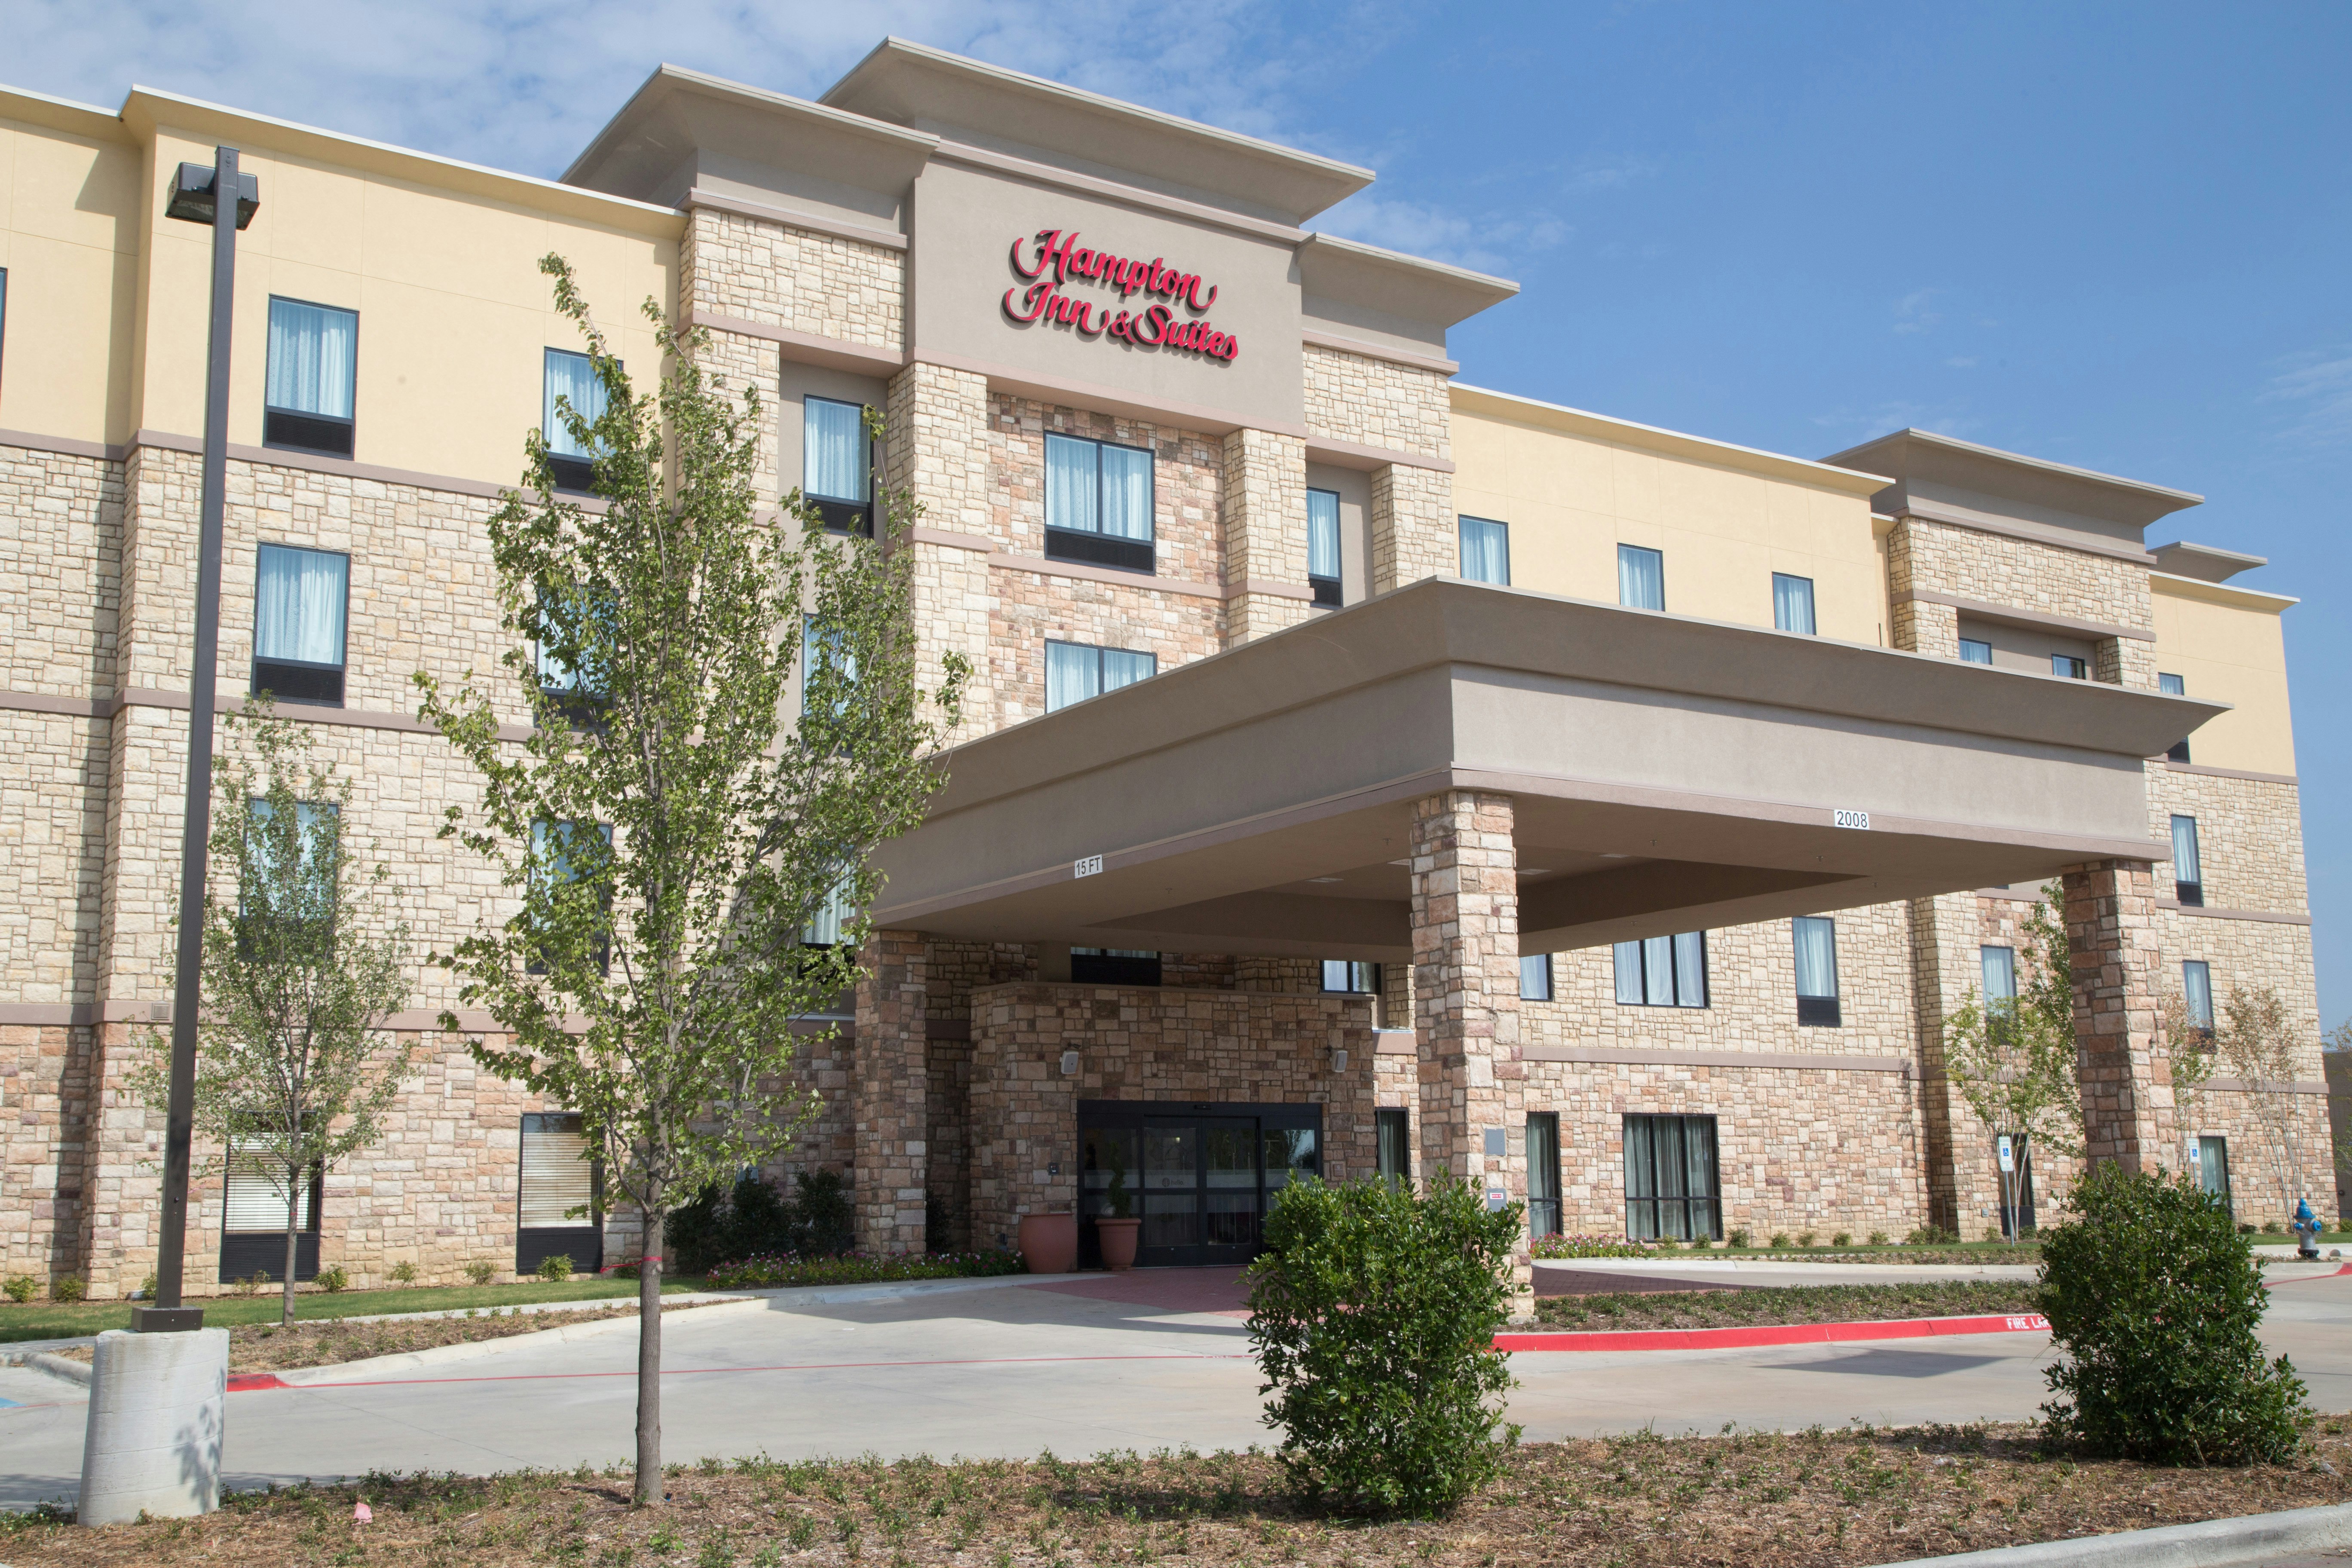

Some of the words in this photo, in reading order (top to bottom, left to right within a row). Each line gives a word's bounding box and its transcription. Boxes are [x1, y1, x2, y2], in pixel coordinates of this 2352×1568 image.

[1010, 230, 1218, 311] Hampton
[1002, 282, 1110, 334] Inn
[1111, 309, 1138, 343] &
[1132, 304, 1239, 360] Suites
[1837, 811, 1867, 828] 2008
[2006, 1317, 2030, 1329] FIRE
[2030, 1316, 2051, 1329] LAN
